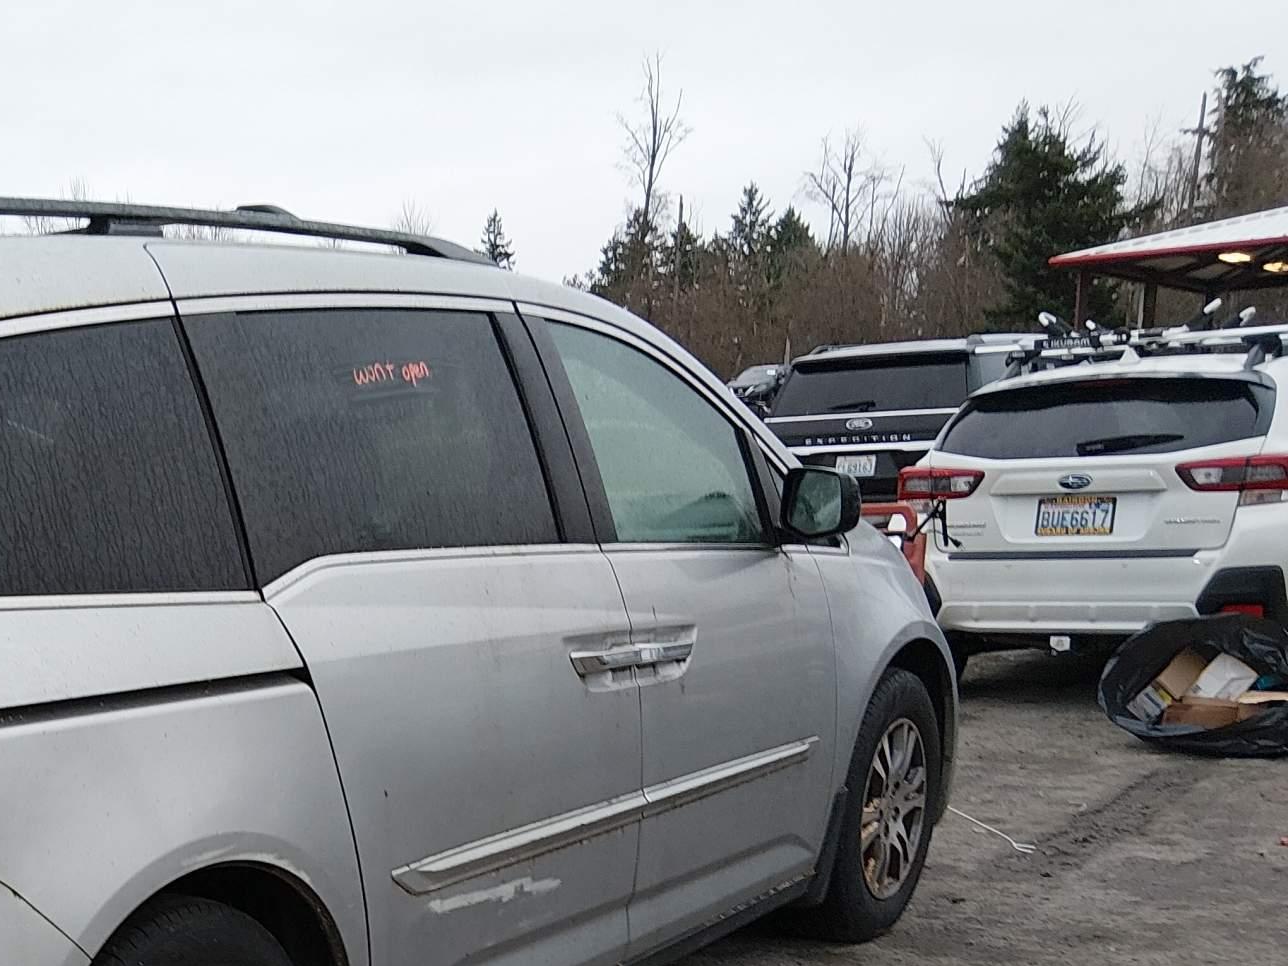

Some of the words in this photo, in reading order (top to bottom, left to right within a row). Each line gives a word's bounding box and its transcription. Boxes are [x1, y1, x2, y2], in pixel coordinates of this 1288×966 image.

[401, 361, 430, 388] open
[805, 433, 912, 446] EXPEDITION
[1040, 509, 1109, 528] BUE6617
